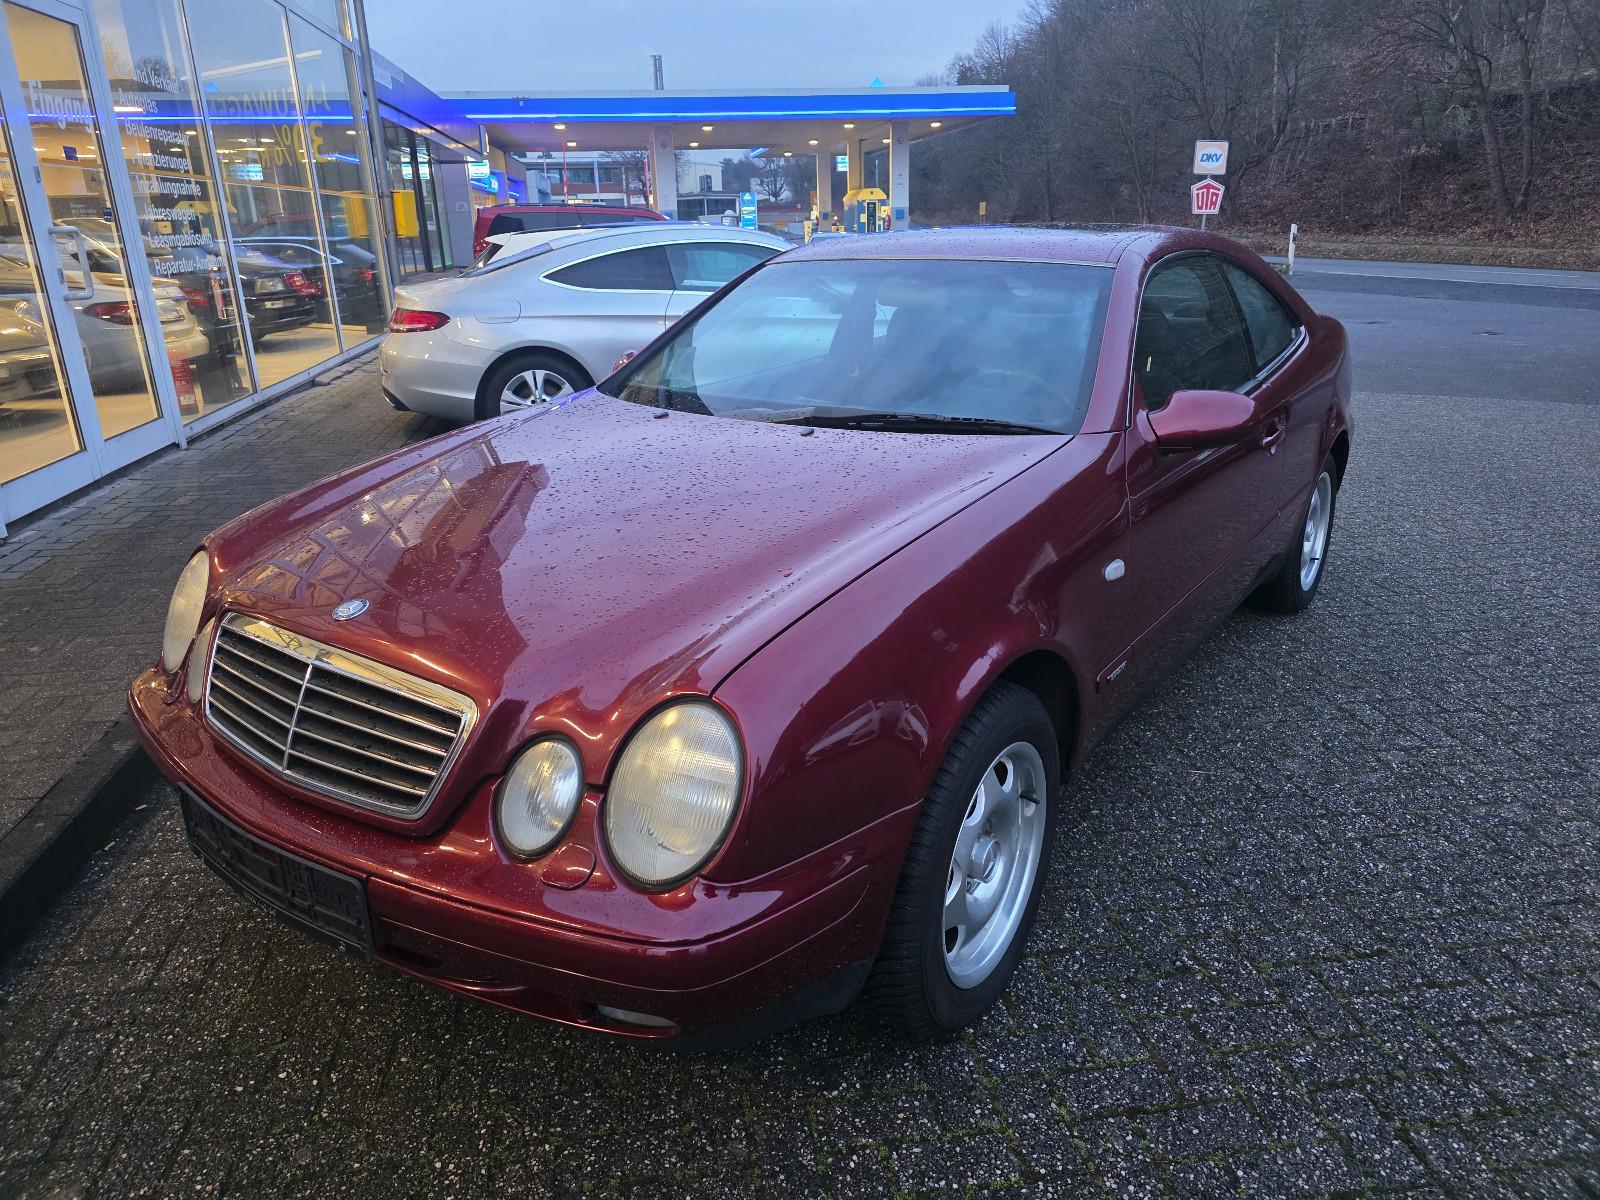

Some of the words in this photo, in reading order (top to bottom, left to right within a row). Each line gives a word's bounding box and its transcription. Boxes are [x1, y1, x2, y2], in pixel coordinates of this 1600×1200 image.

[29, 80, 93, 133] Eingang
[1200, 153, 1222, 163] DKV
[1196, 183, 1221, 211] UTA
[143, 203, 196, 225] Jahreswagen
